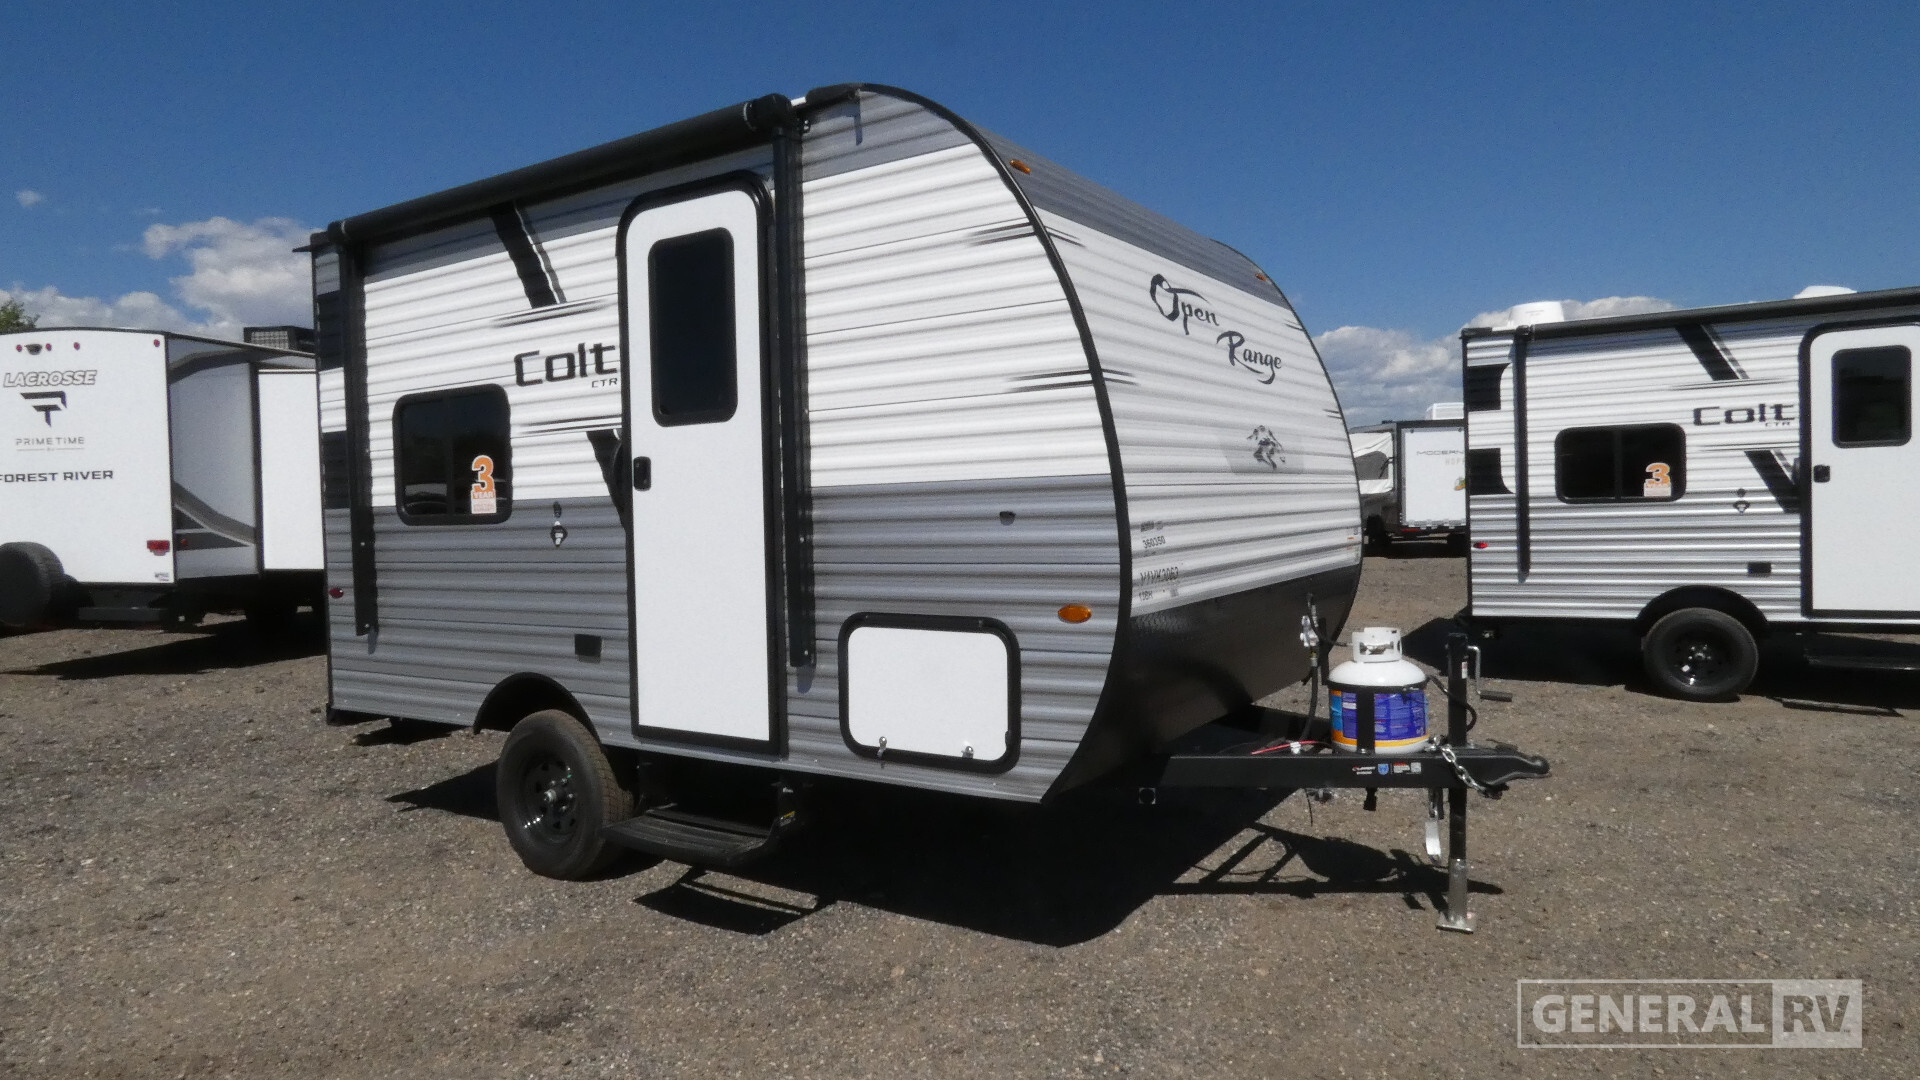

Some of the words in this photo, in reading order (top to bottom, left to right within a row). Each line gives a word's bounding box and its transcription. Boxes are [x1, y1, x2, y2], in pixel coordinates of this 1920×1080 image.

[1150, 274, 1219, 335] Open
[514, 342, 618, 387] Colt
[1216, 331, 1282, 385] Range
[3, 370, 98, 388] LACROSSE
[591, 377, 618, 388] CTR
[1693, 403, 1796, 426] Colt
[63, 470, 114, 480] RIVER
[471, 455, 495, 493] 3
[1645, 462, 1671, 484] 3
